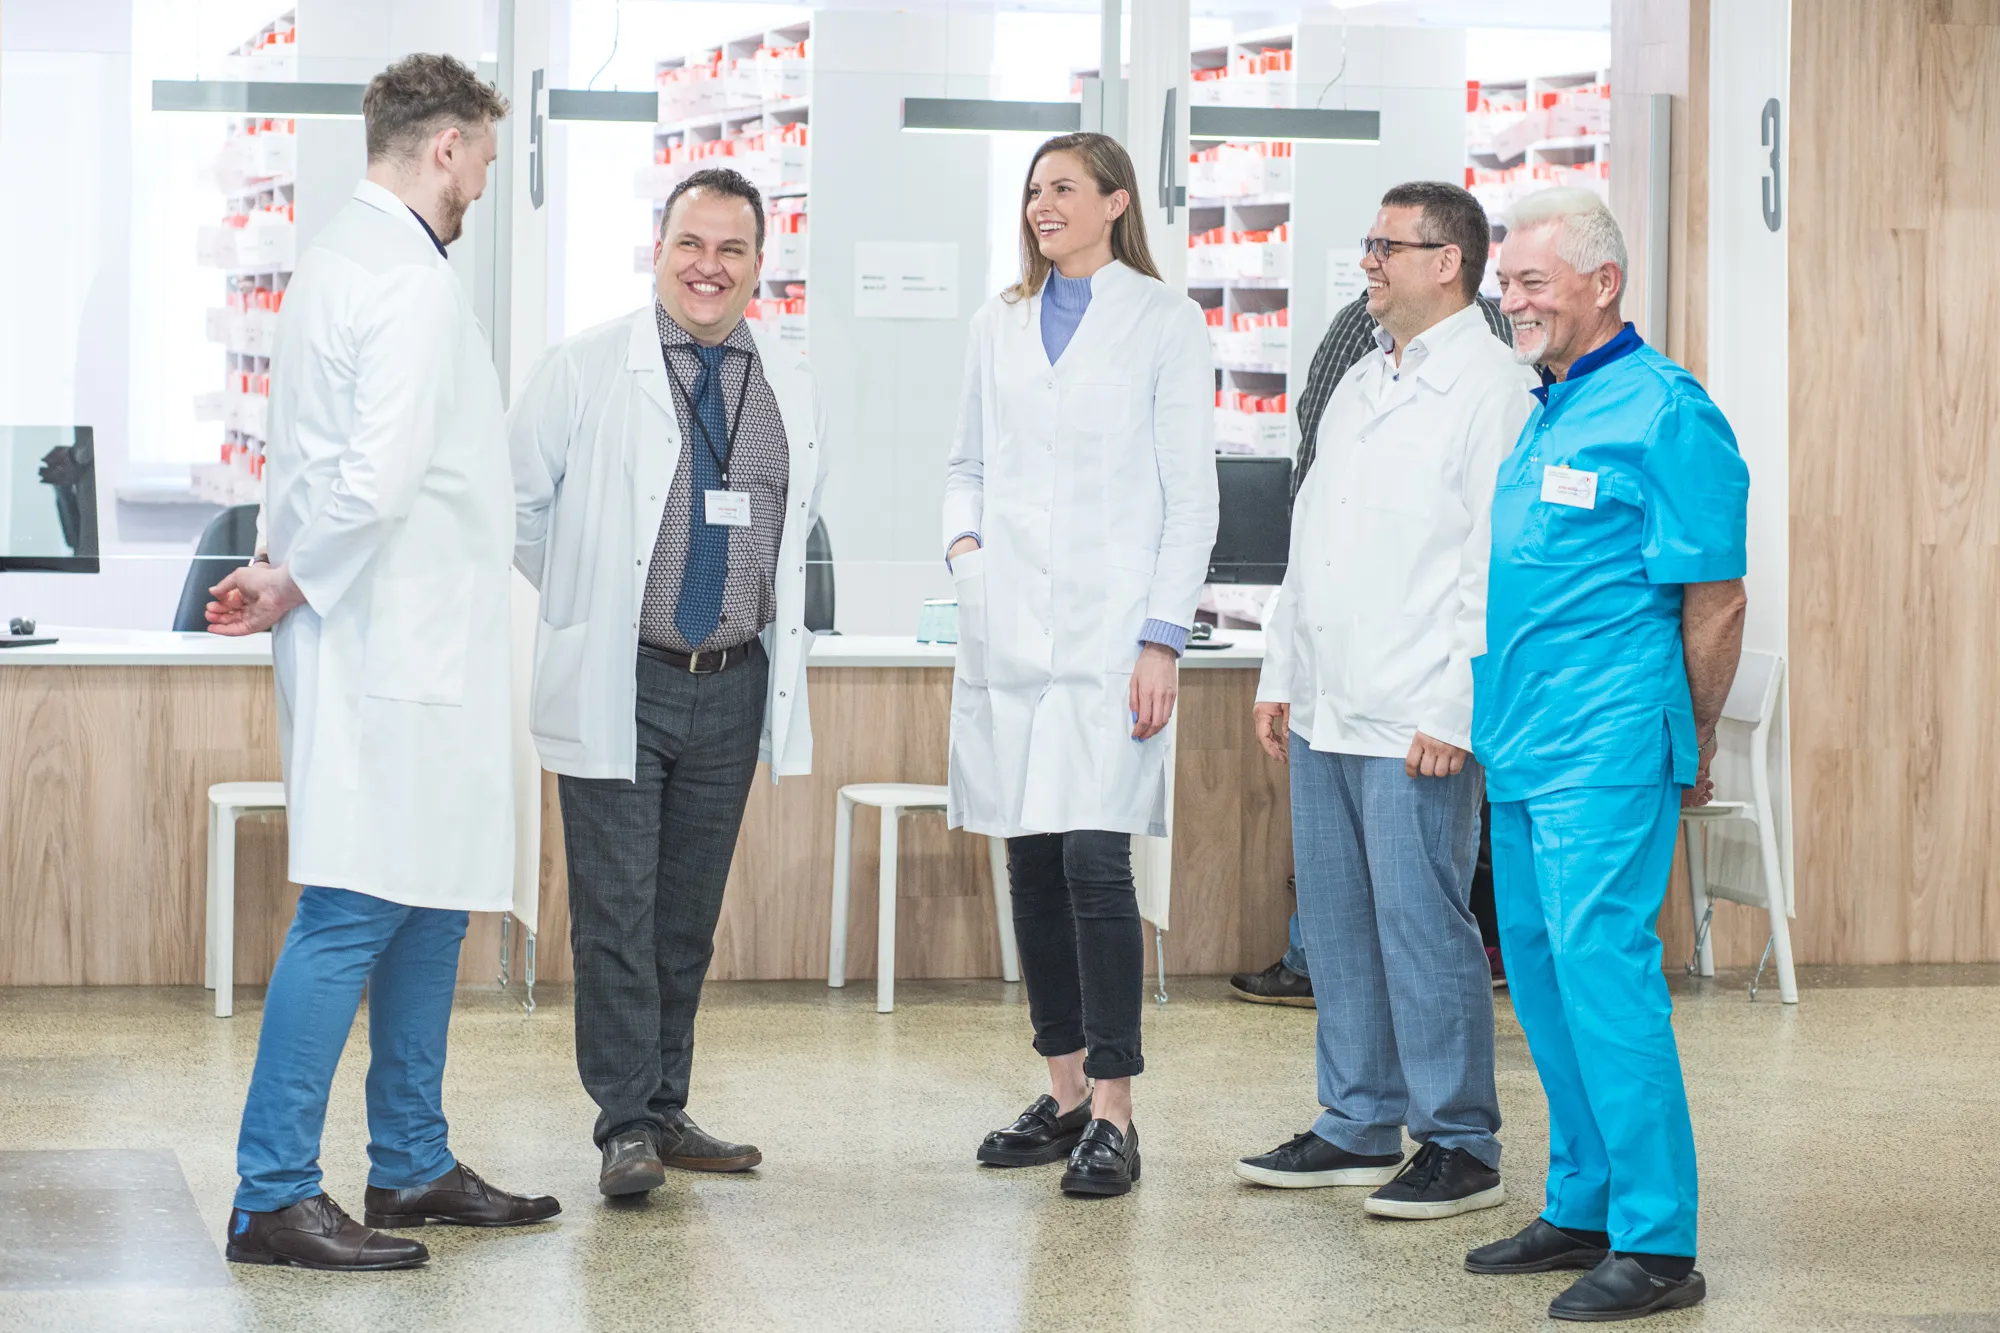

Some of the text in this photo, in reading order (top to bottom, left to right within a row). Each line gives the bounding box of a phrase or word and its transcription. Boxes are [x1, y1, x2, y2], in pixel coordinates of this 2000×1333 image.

[530, 69, 544, 210] 5
[1159, 87, 1186, 225] 4
[1762, 98, 1781, 232] 3
